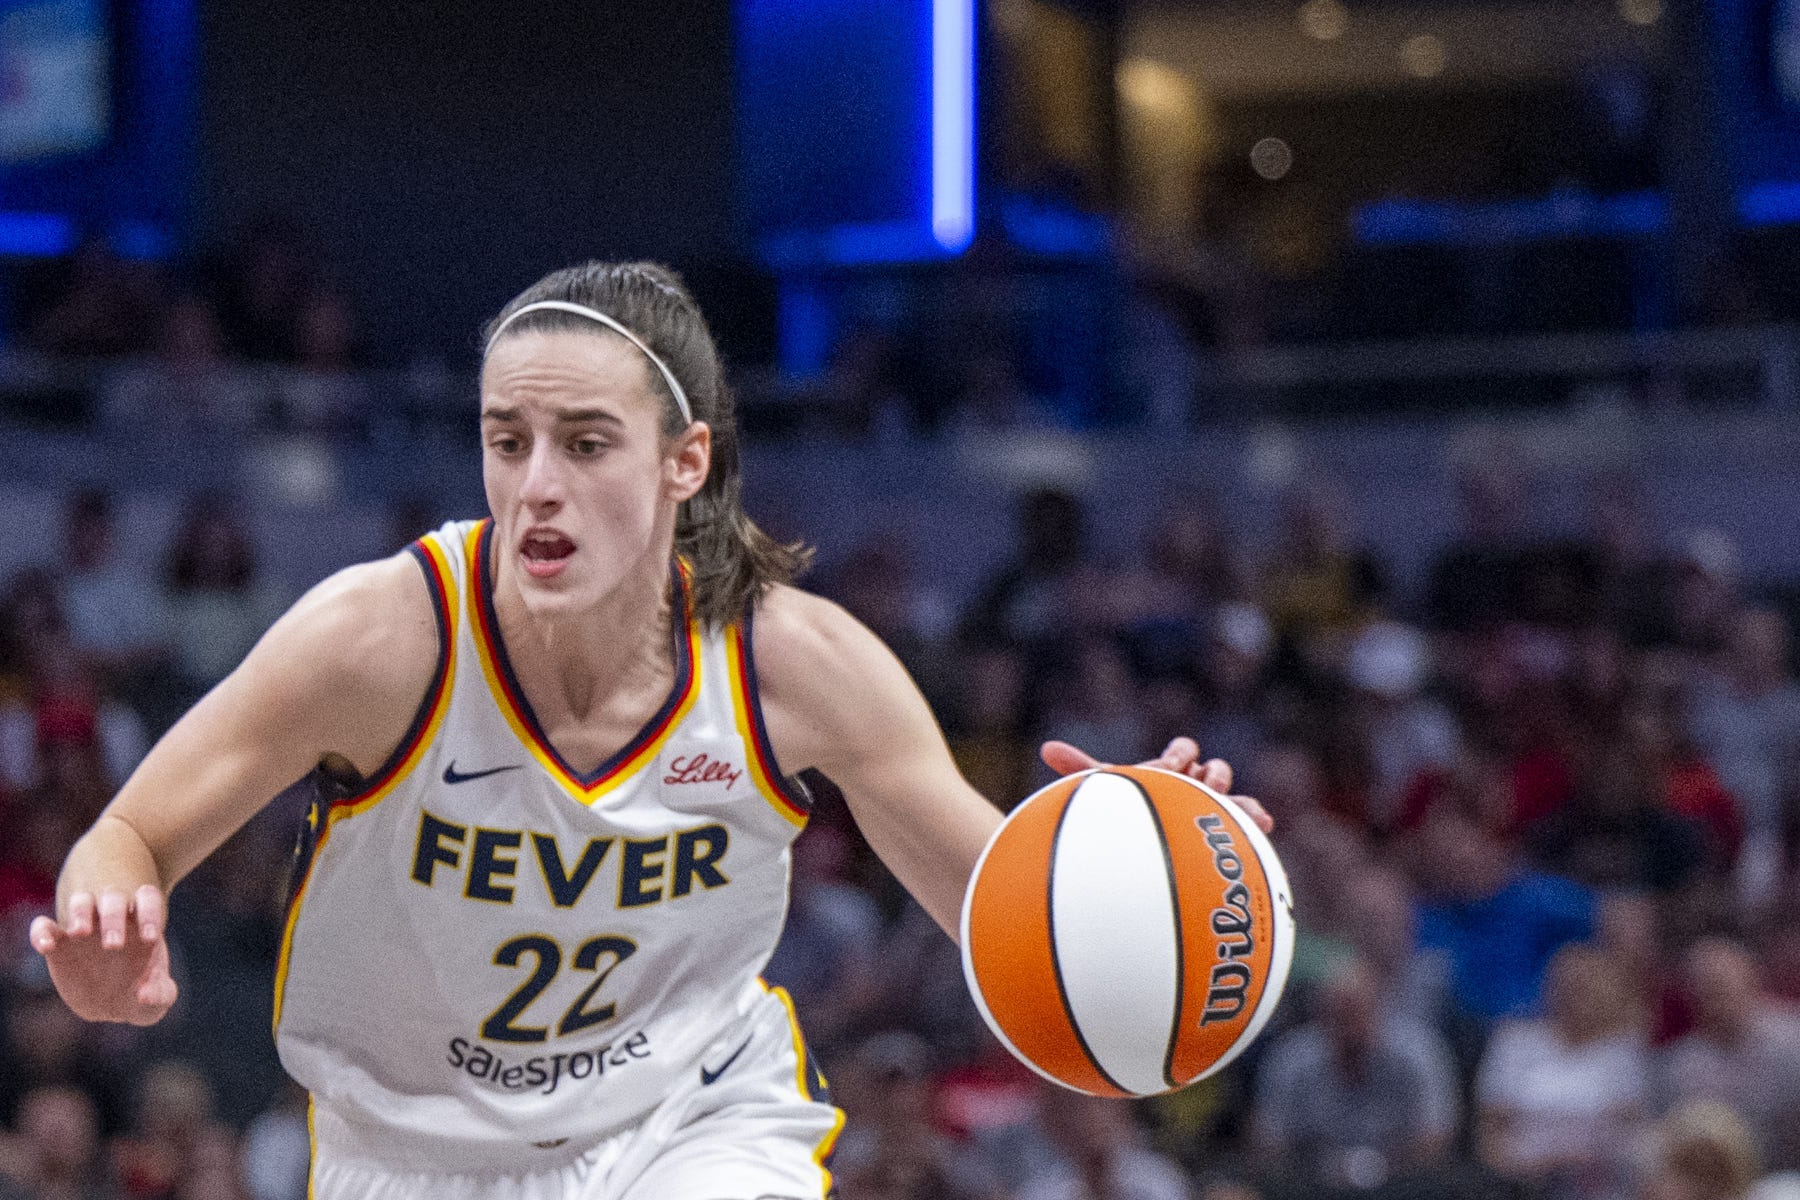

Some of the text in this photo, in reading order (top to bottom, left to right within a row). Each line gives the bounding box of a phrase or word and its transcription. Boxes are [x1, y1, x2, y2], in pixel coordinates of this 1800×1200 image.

[663, 752, 743, 791] Lilly
[410, 807, 731, 910] FEVER
[1194, 812, 1253, 1028] Wilson
[478, 932, 640, 1045] 22
